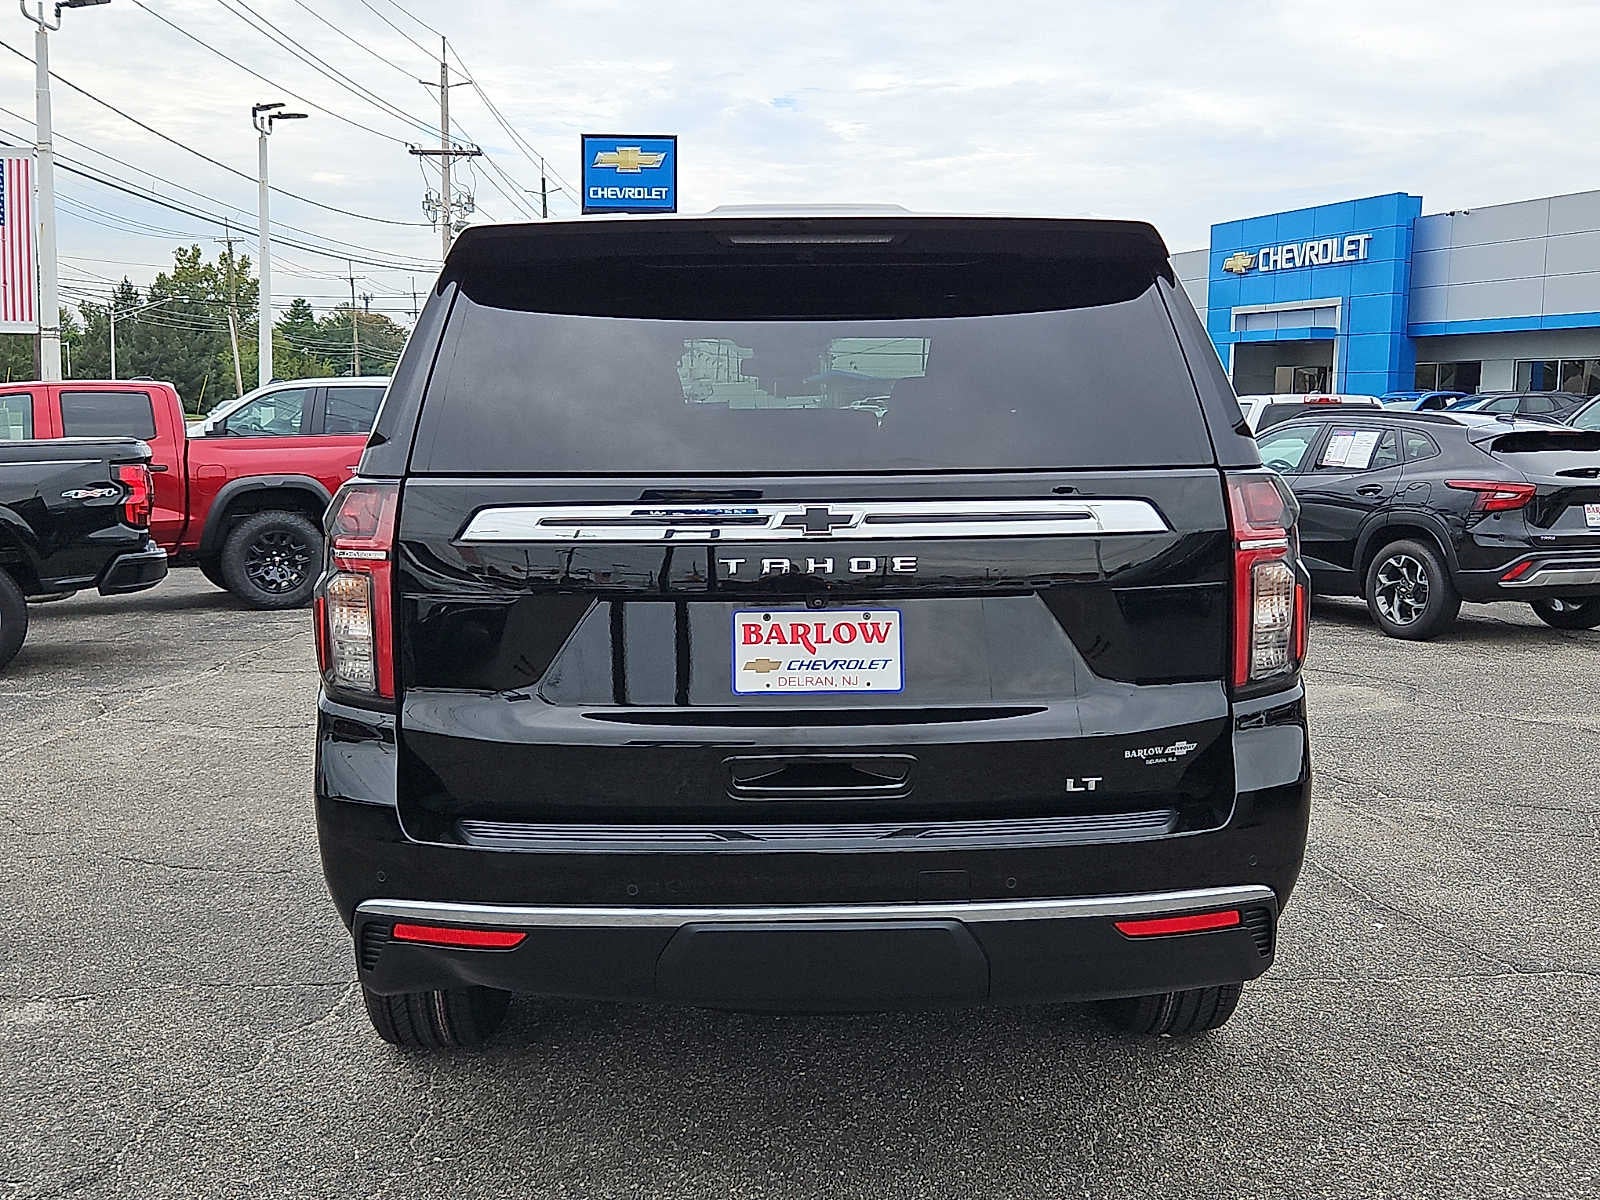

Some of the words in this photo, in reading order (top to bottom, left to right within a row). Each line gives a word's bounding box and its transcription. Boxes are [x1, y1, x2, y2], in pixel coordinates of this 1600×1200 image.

[589, 187, 669, 200] CHEVROLET
[1258, 233, 1372, 272] CHEVROLET
[718, 556, 918, 575] TAHOE
[741, 621, 893, 656] BARLOW
[786, 658, 893, 672] CHEVROLET
[778, 676, 838, 688] DELRAN,
[841, 675, 860, 687] NJ
[1124, 746, 1164, 760] BARLOW
[1066, 777, 1103, 792] LT
